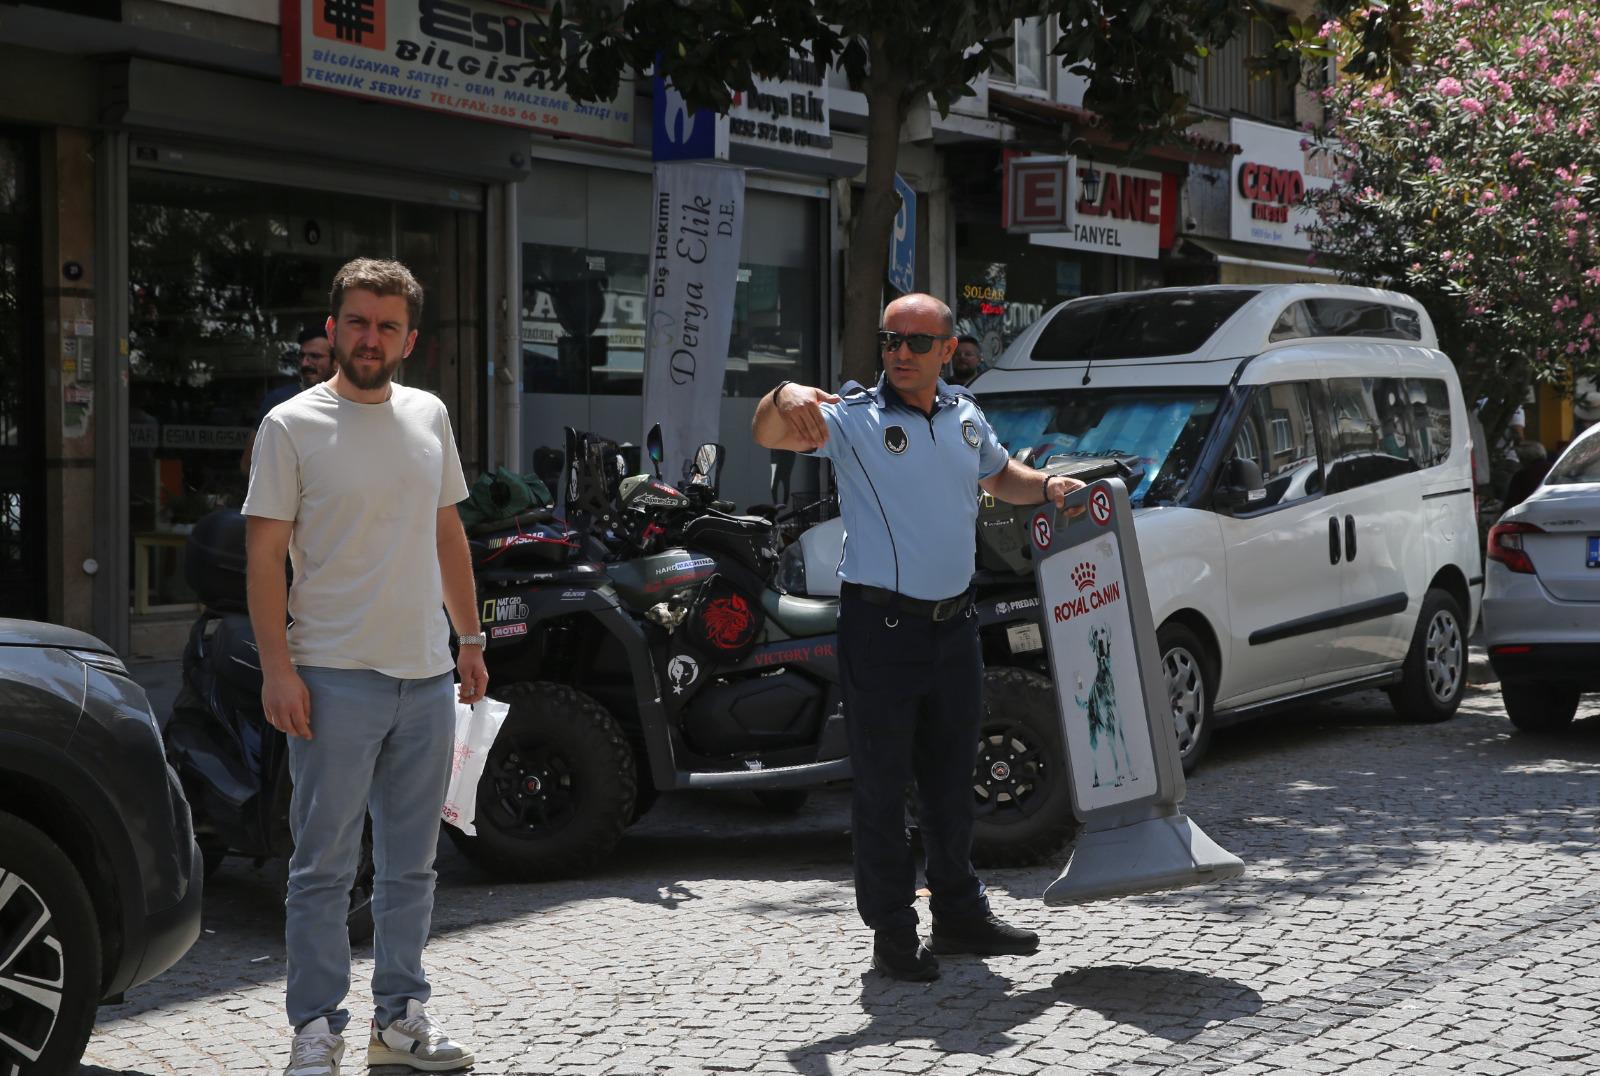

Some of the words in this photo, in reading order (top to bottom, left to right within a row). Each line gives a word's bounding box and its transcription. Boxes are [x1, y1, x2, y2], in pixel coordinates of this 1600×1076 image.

[306, 67, 364, 89] TEKNİK
[369, 80, 422, 100] SERVİS
[312, 49, 400, 79] BİLGİSAYAR
[406, 70, 449, 88] SATIŞI
[465, 82, 495, 97] OEM
[504, 90, 569, 112] MALZEME
[573, 104, 610, 120] SATIŞI
[615, 111, 629, 123] VE
[1238, 162, 1304, 206] CEMO
[676, 195, 711, 264] Elik
[670, 282, 709, 385] Derya
[496, 603, 530, 621] WILD
[1009, 597, 1040, 611] PREDAT
[1054, 596, 1090, 623] ROYAL
[1090, 580, 1121, 609] CANIN
[495, 625, 526, 637] MOTUL
[754, 647, 810, 666] VICTORY
